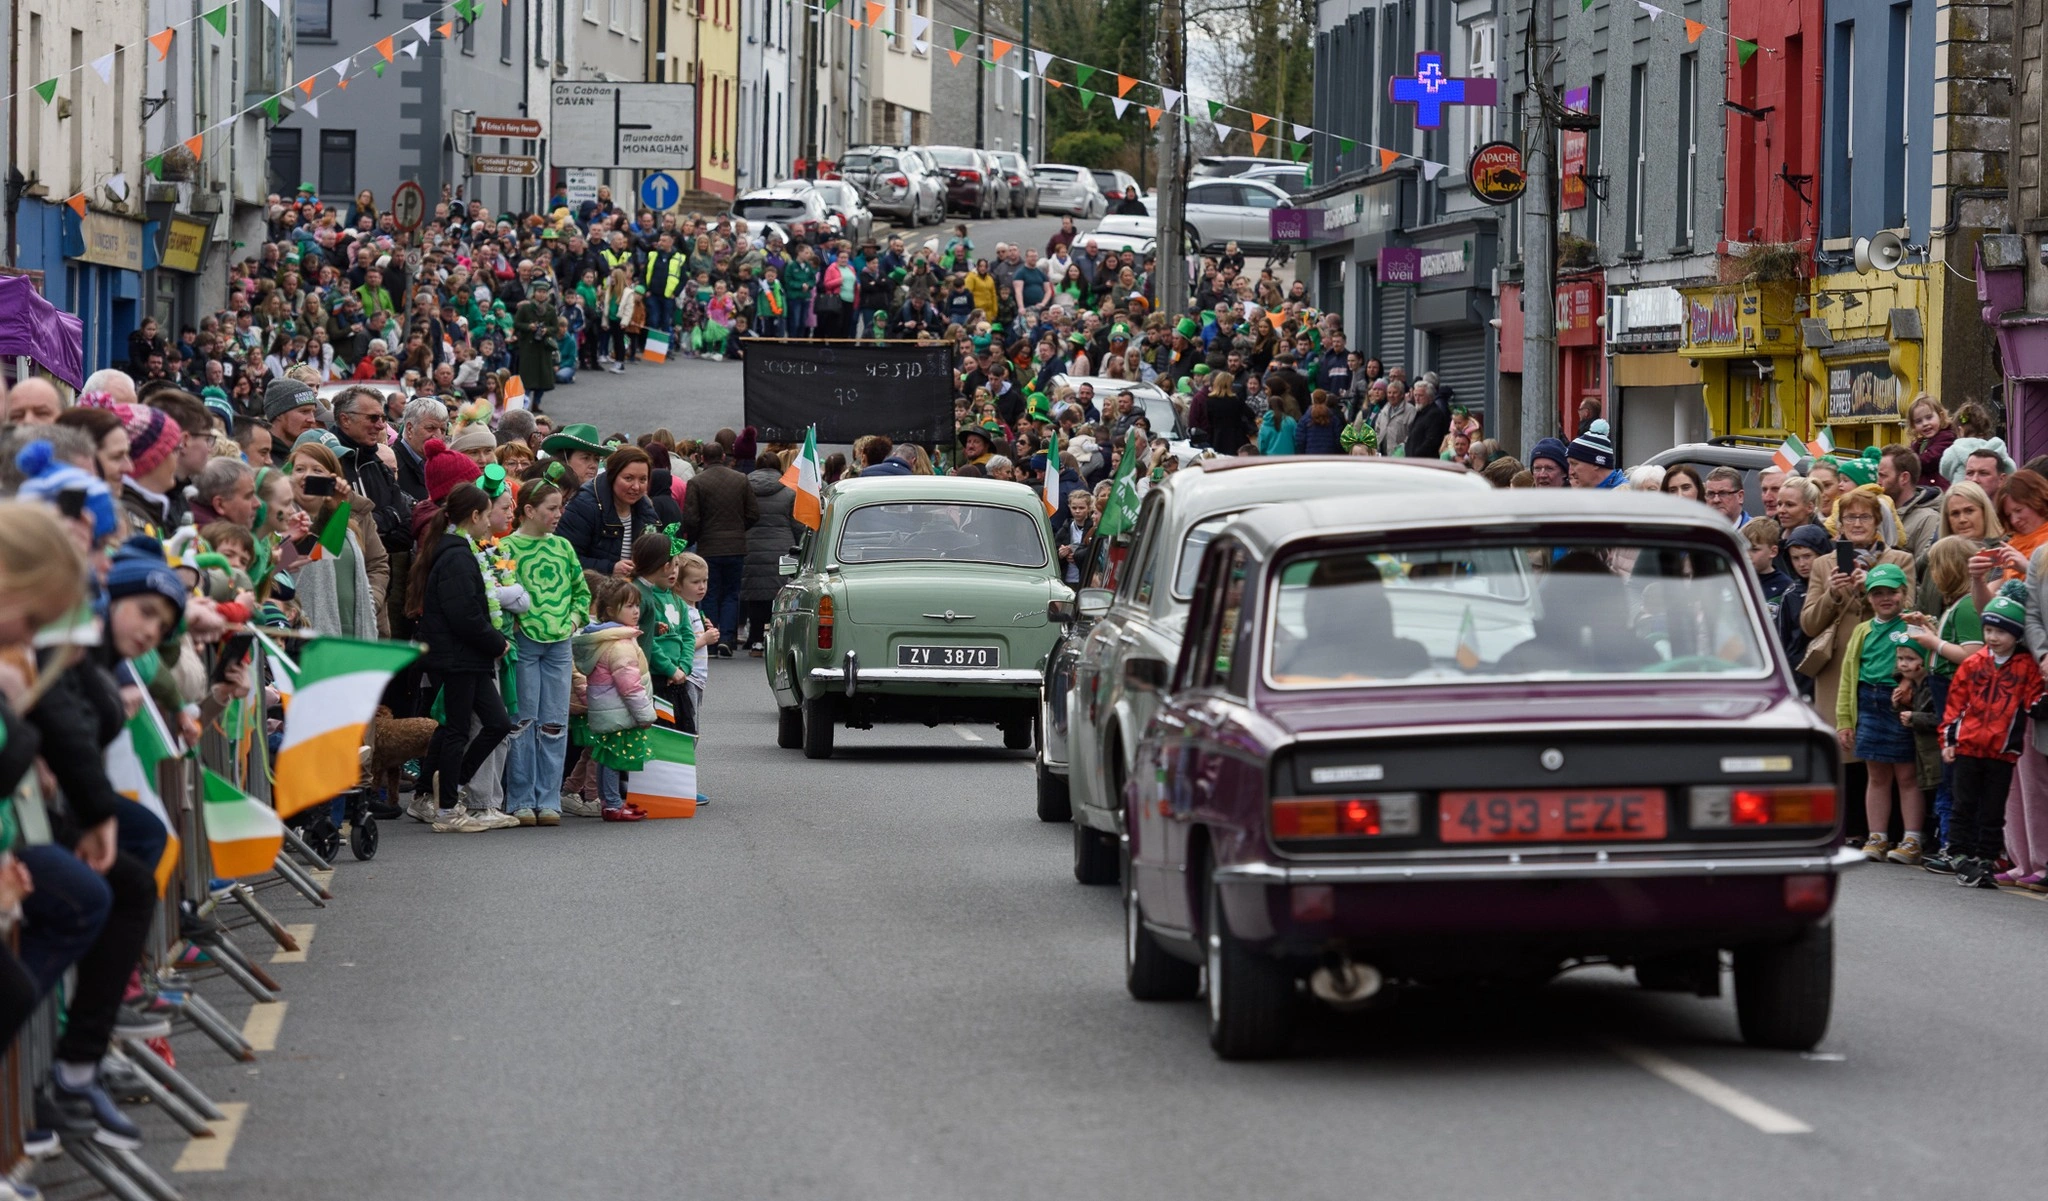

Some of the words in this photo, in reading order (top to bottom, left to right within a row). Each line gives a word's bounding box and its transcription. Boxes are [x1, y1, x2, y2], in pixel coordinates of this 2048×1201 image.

[555, 86, 569, 94] An
[556, 97, 594, 106] CAVAN
[622, 144, 689, 153] MONAGHAN
[1480, 152, 1518, 164] APACHE
[1277, 221, 1301, 232] stay
[1277, 229, 1301, 238] well
[1388, 261, 1414, 273] stay
[1388, 270, 1413, 281] well
[1830, 393, 1851, 414] EXPRESS
[910, 648, 930, 664] ZV
[944, 649, 987, 665] 3870
[1457, 797, 1541, 835] 493
[1563, 796, 1647, 833] EZE
